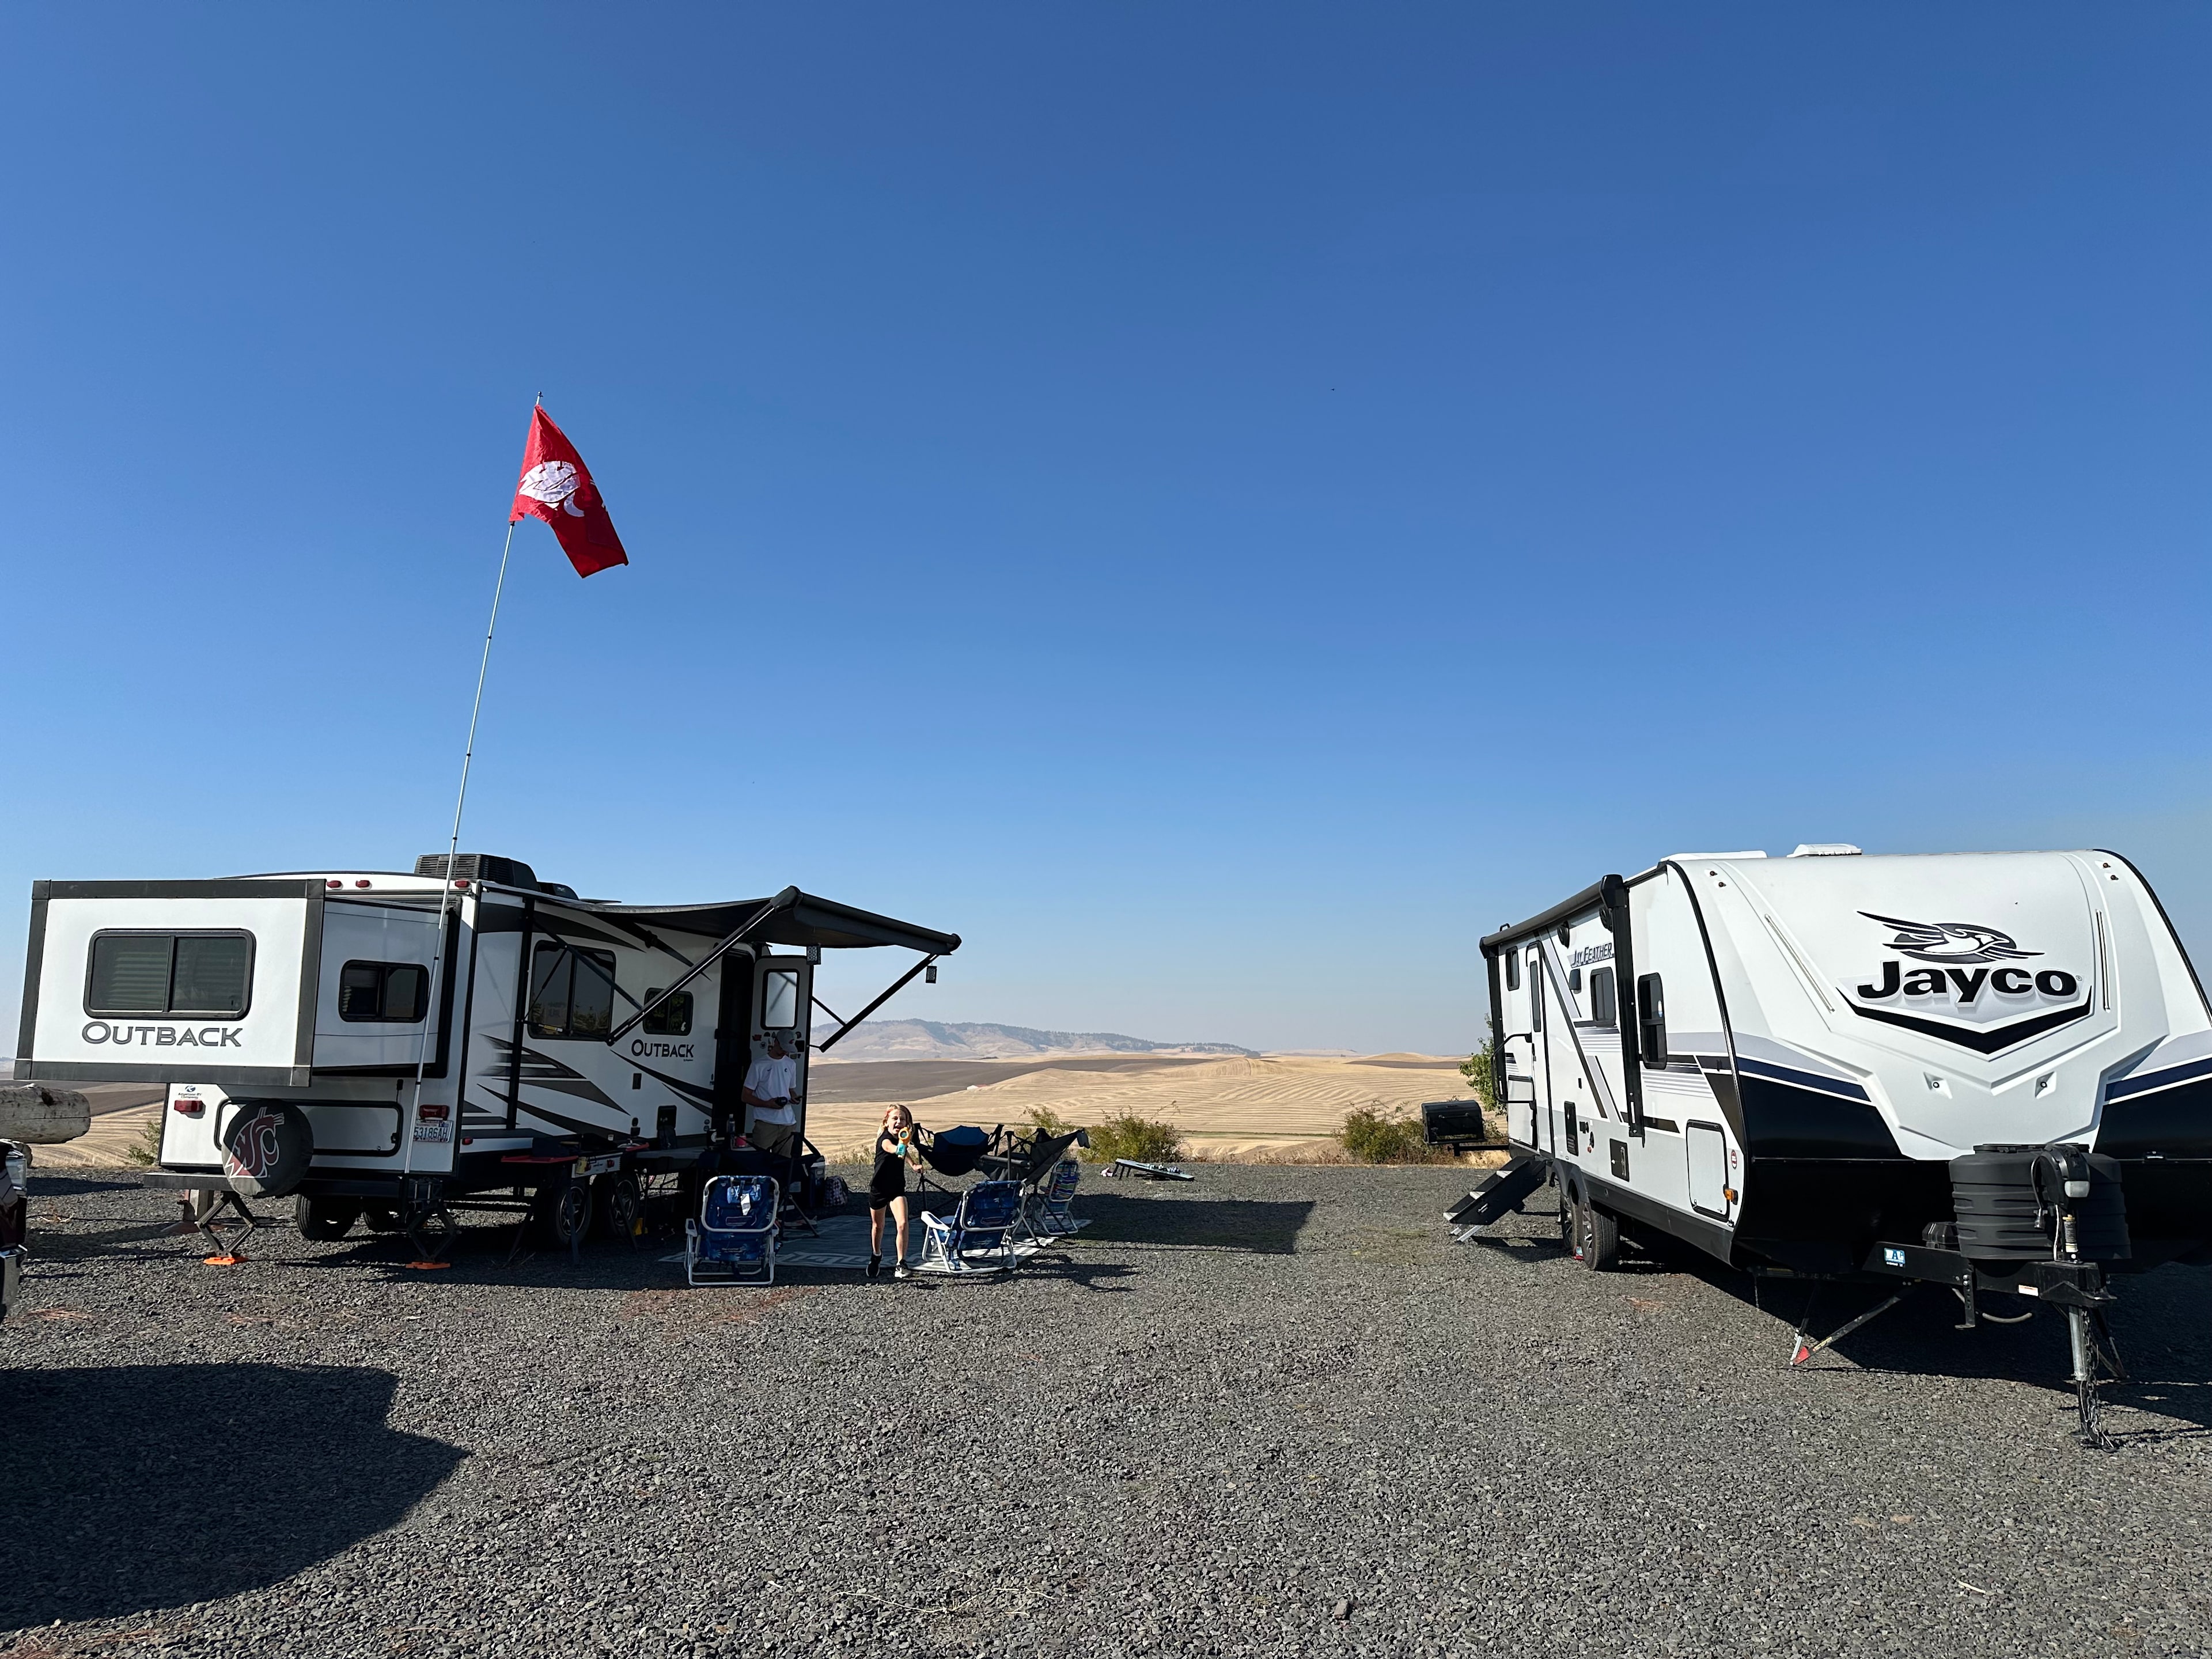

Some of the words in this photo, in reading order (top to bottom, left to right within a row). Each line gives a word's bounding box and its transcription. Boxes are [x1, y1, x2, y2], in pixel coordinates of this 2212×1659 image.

[1571, 950, 1583, 966] JAY
[1584, 942, 1612, 963] FEATHER
[1857, 960, 2078, 1006] Jayco
[414, 1127, 448, 1138] 53186AH
